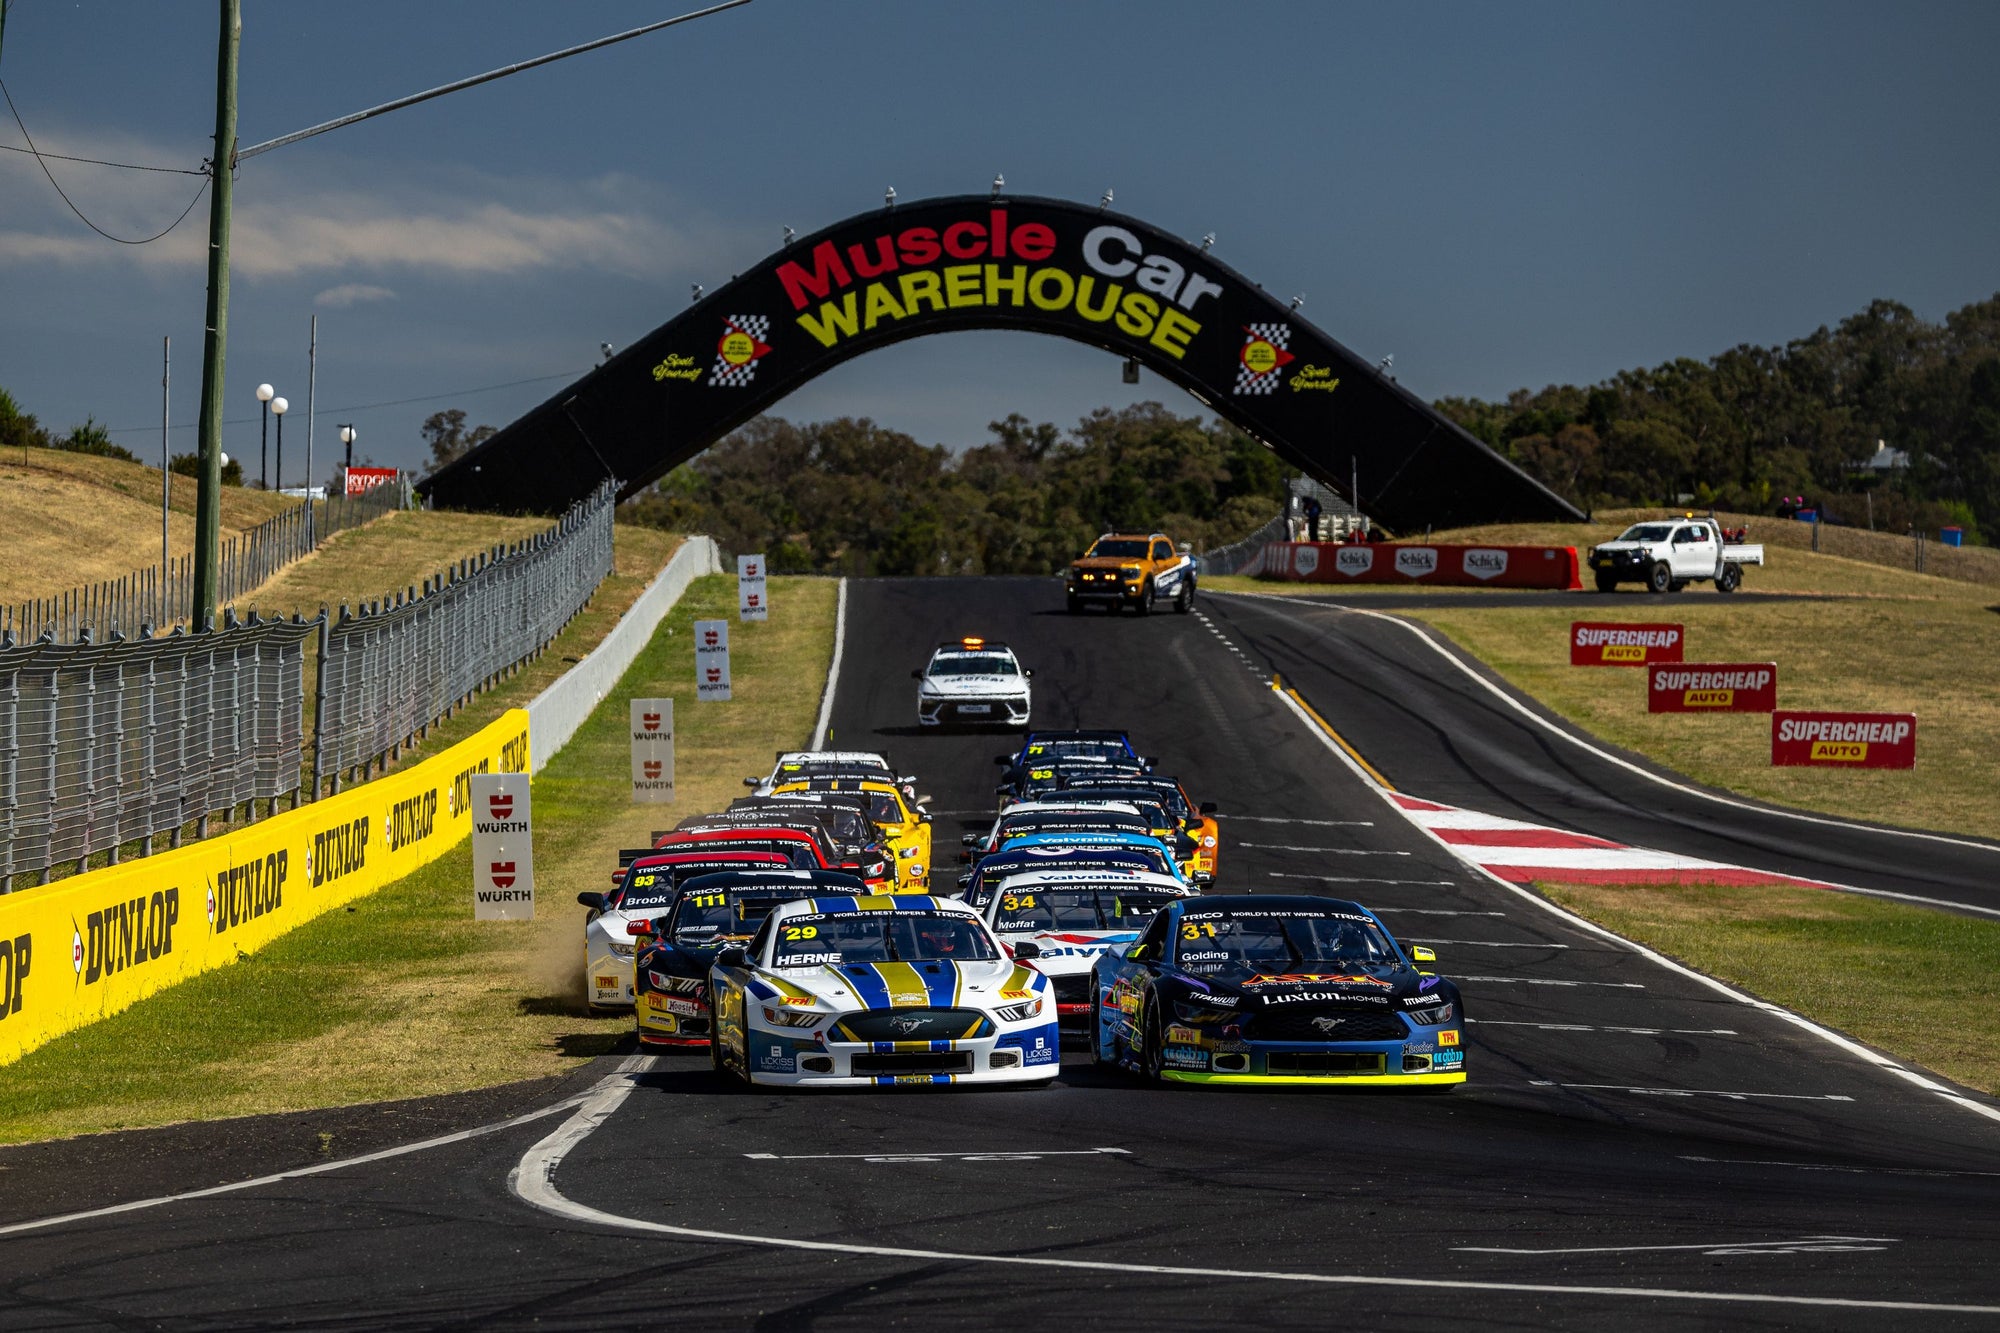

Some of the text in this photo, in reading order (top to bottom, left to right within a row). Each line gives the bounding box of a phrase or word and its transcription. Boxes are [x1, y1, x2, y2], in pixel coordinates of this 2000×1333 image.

[775, 209, 1224, 311] Muscle Car
[797, 264, 1202, 360] WAREHOUSE
[348, 474, 395, 488] RYDG
[1340, 552, 1368, 567] Schick
[1400, 553, 1432, 567] Schick
[1467, 554, 1504, 570] Schick
[1576, 628, 1679, 649] SUPERCHEAP
[1607, 649, 1642, 658] AUTO
[1654, 670, 1770, 691] SUPERCHEAP
[1689, 693, 1729, 703] AUTO
[1779, 719, 1909, 744] SUPERCHEAP
[1817, 745, 1861, 757] AUTO
[1032, 770, 1053, 780] 63
[453, 757, 488, 819] DUN
[392, 788, 437, 852] DUNLOP
[477, 822, 528, 834] WÜRTH
[1005, 824, 1036, 833] TRICO
[1115, 823, 1147, 831] TRICO
[1038, 835, 1128, 844] Valvoline
[313, 816, 369, 888] DUNLOP
[637, 865, 670, 874] TRICO
[754, 862, 787, 870] TRICO
[982, 863, 1019, 873] TRICO
[1112, 861, 1149, 869] TRICO
[634, 875, 655, 887] 93
[1039, 874, 1141, 882] Valvoline
[216, 848, 288, 934] DUNLOP
[478, 890, 532, 902] WÜRTH
[685, 887, 724, 897] TRICO
[824, 885, 863, 893] TRICO
[1005, 886, 1045, 895] TRICO
[1145, 886, 1185, 895] TRICO
[626, 895, 667, 906] Brook
[692, 893, 726, 908] 111
[1003, 895, 1036, 911] 34
[784, 913, 826, 924] TRICO
[932, 911, 975, 919] TRICO
[1180, 912, 1223, 921] TRICO
[1331, 912, 1374, 923] TRICO
[999, 920, 1035, 929] Moffat
[85, 887, 179, 986] DUNLOP
[786, 926, 818, 941] 29
[1182, 922, 1216, 940] 31
[776, 953, 842, 966] HERNE
[1182, 951, 1229, 961] Golding
[597, 989, 619, 999] Hoosier
[1002, 990, 1029, 998] TFH
[1189, 992, 1239, 1005] TITANIUM
[1263, 991, 1388, 1005] Luxton HOMES
[1403, 993, 1441, 1005] TITANIUM
[785, 997, 810, 1005] TFH
[1175, 1029, 1194, 1040] TFH
[1442, 1033, 1455, 1044] TFH
[1026, 1048, 1051, 1058] LICKISS
[1401, 1042, 1433, 1055] Hoosier
[1443, 1049, 1455, 1066] gbb
